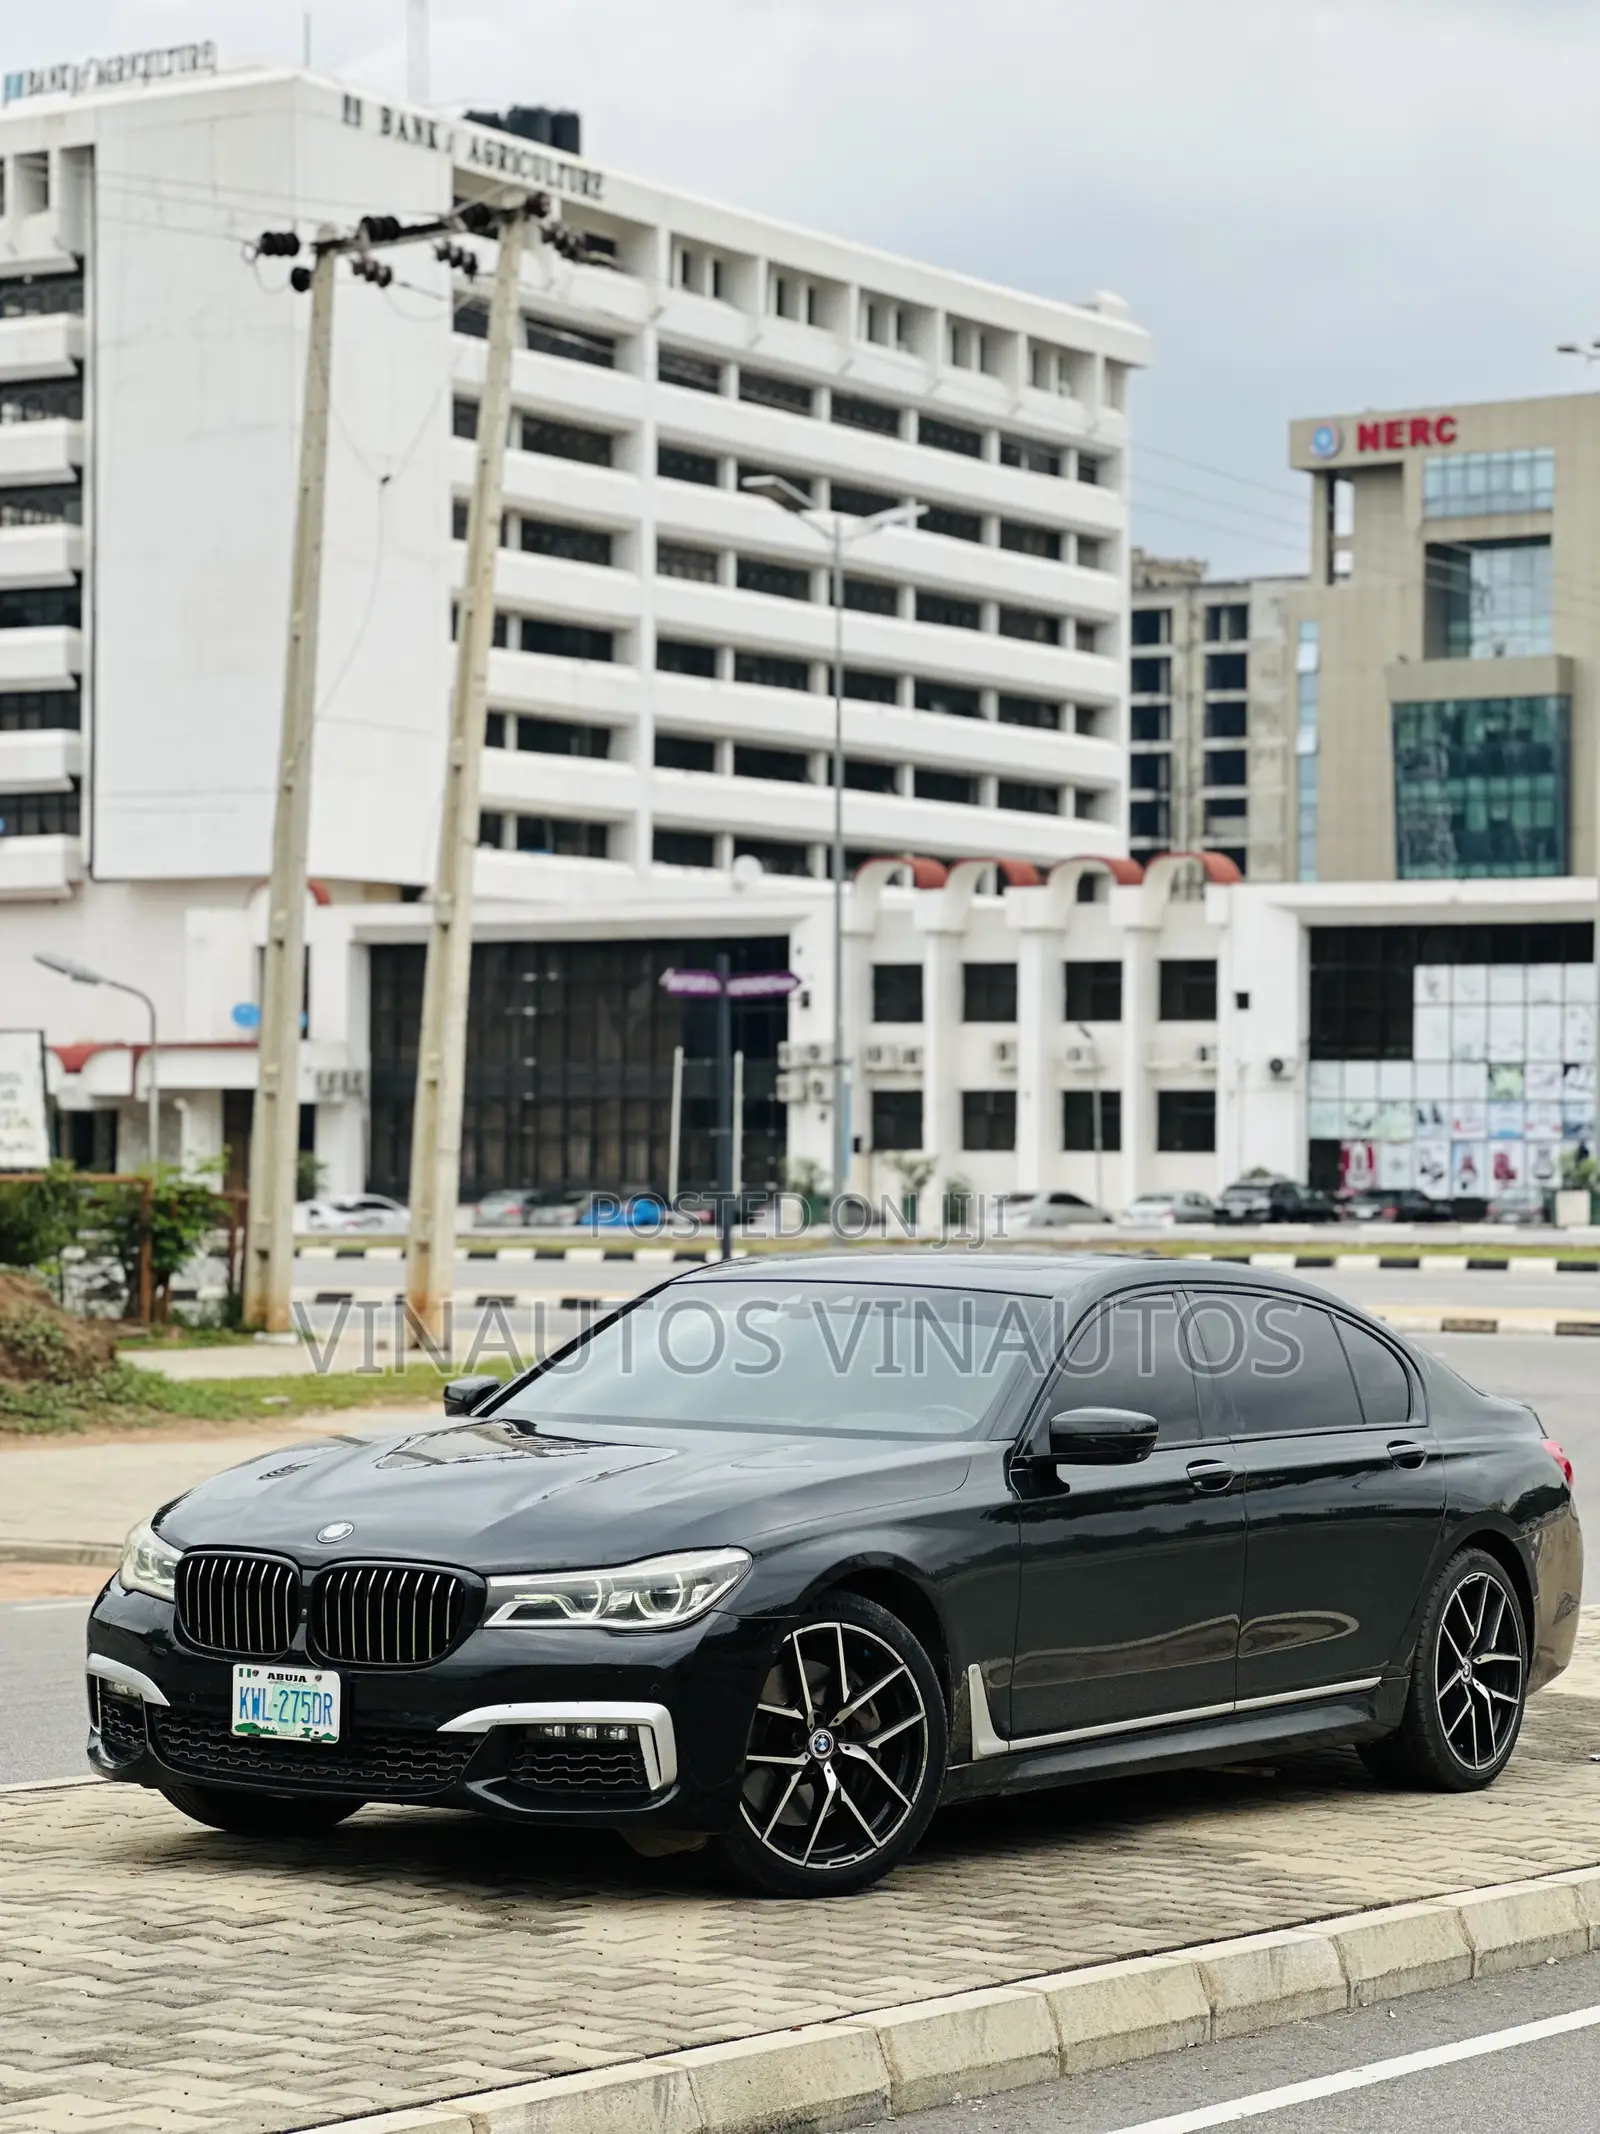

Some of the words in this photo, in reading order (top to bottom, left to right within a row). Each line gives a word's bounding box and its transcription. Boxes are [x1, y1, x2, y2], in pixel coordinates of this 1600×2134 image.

[380, 105, 438, 151] BANK
[467, 134, 605, 200] AGRICULTURE
[1357, 416, 1457, 453] NERC
[267, 1672, 307, 1683] ABUJA
